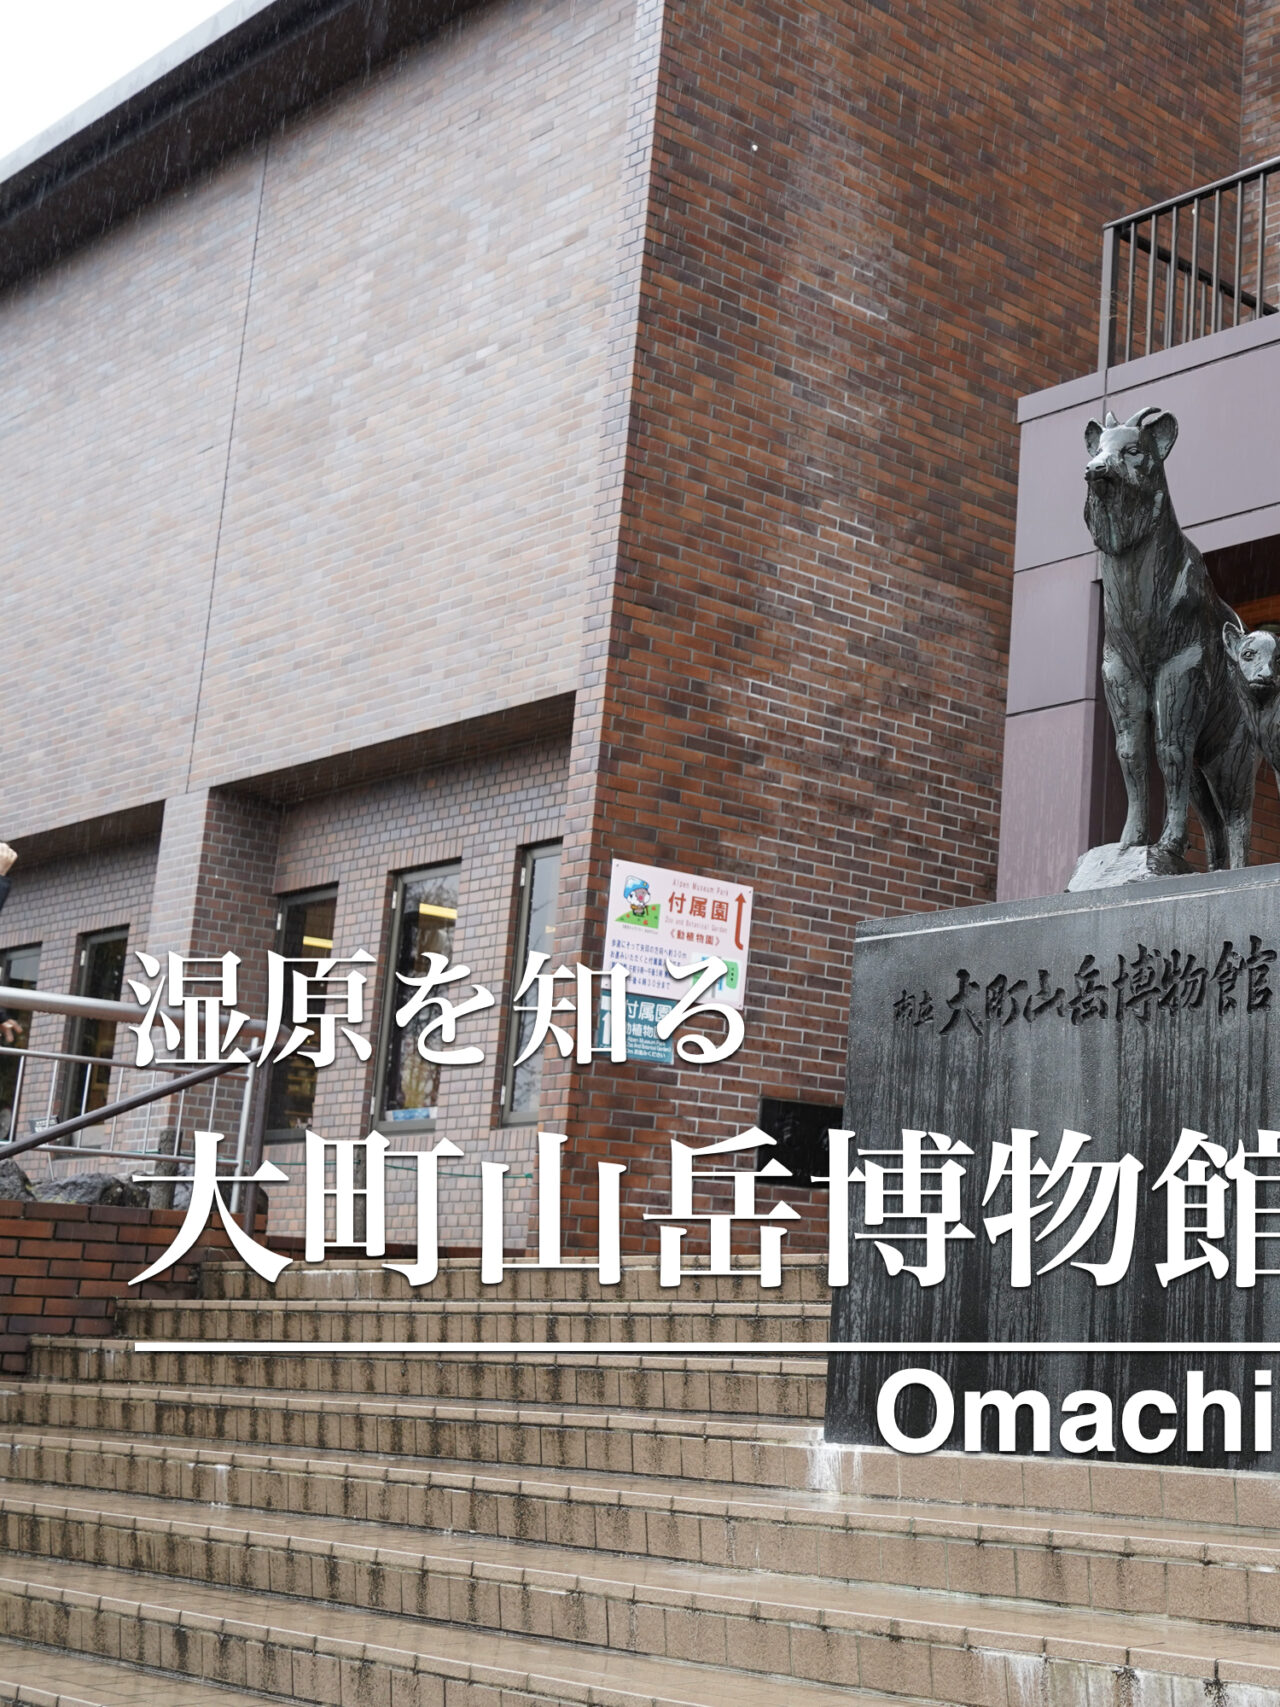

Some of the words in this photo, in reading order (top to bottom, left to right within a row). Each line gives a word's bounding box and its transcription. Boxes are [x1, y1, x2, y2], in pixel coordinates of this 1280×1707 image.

[668, 891, 729, 923] 付属園
[939, 934, 1278, 1036] 大町山岳博物館
